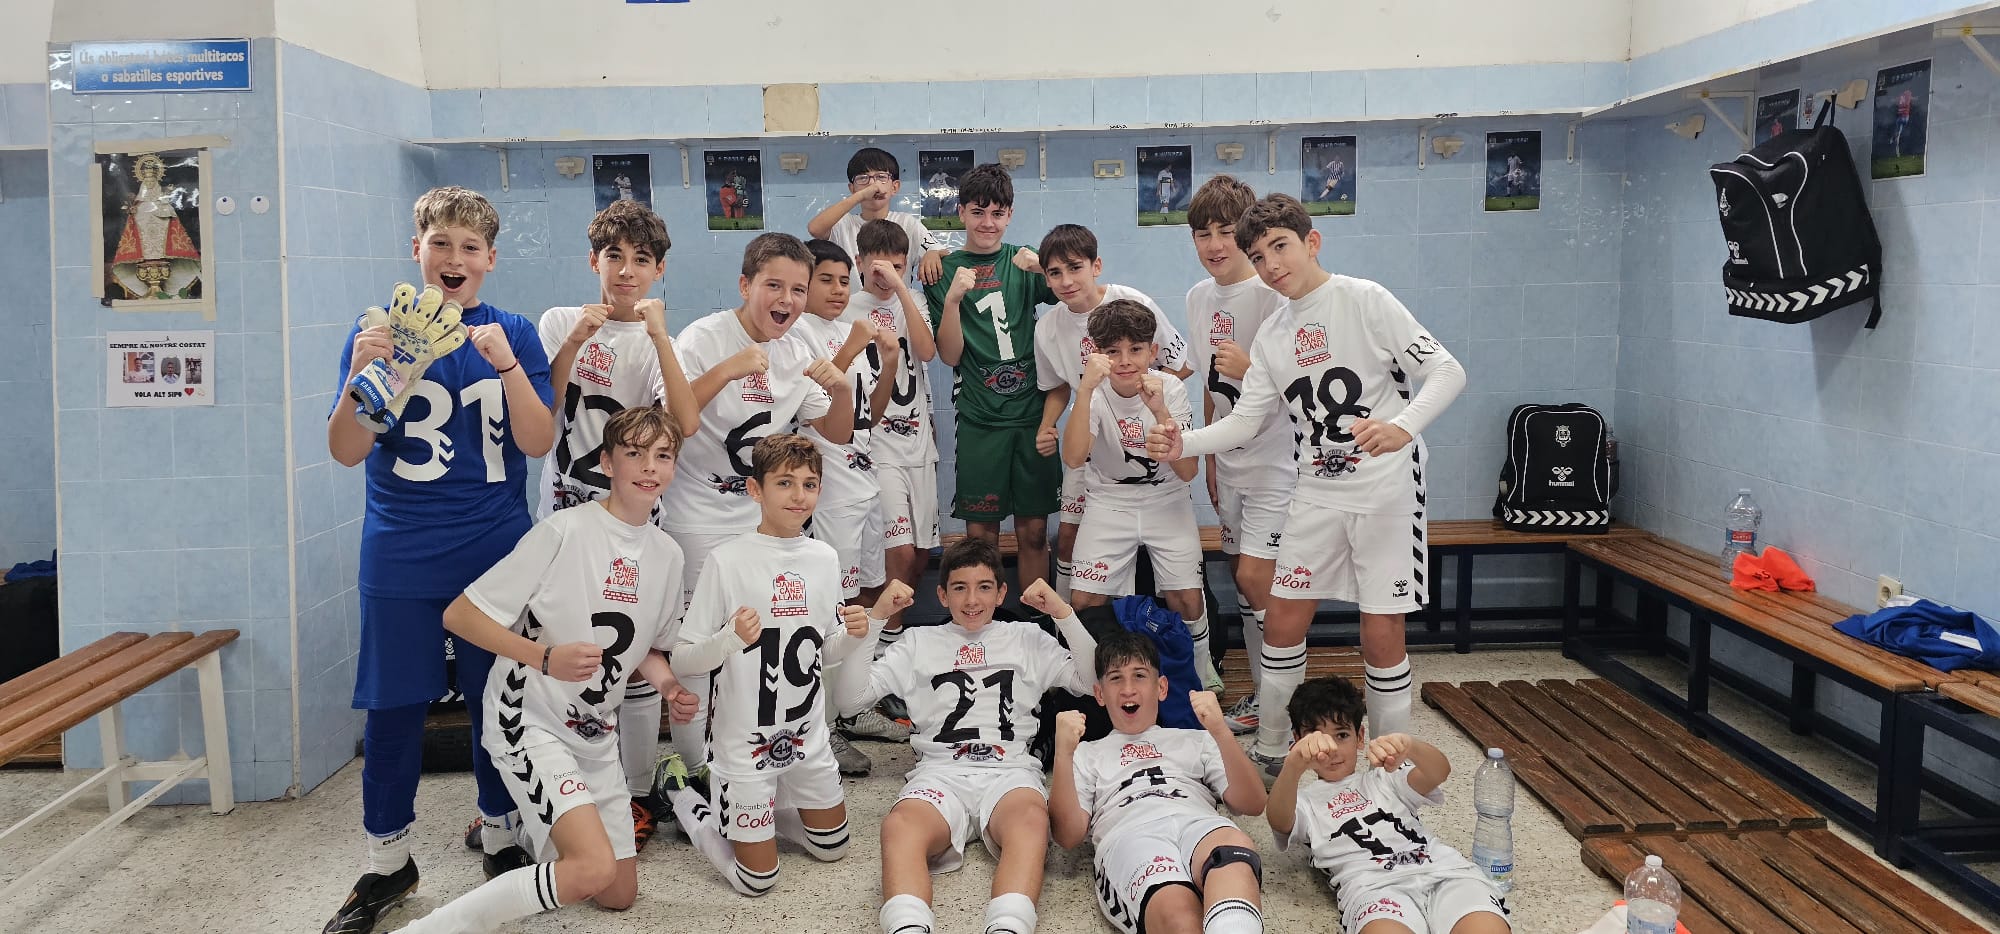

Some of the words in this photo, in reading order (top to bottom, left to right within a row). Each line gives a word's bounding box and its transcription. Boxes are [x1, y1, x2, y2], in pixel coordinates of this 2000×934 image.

[101, 72, 109, 82] o
[112, 68, 163, 83] sabatilles
[166, 68, 224, 85] esportives
[187, 49, 244, 63] multitacos
[974, 290, 1016, 361] 1
[1284, 366, 1370, 447] 18
[392, 379, 506, 483] 31
[1548, 479, 1575, 487] hummel
[885, 525, 912, 539] olón
[1274, 573, 1311, 588] olón
[743, 625, 823, 727] 19
[931, 670, 1015, 743] 21
